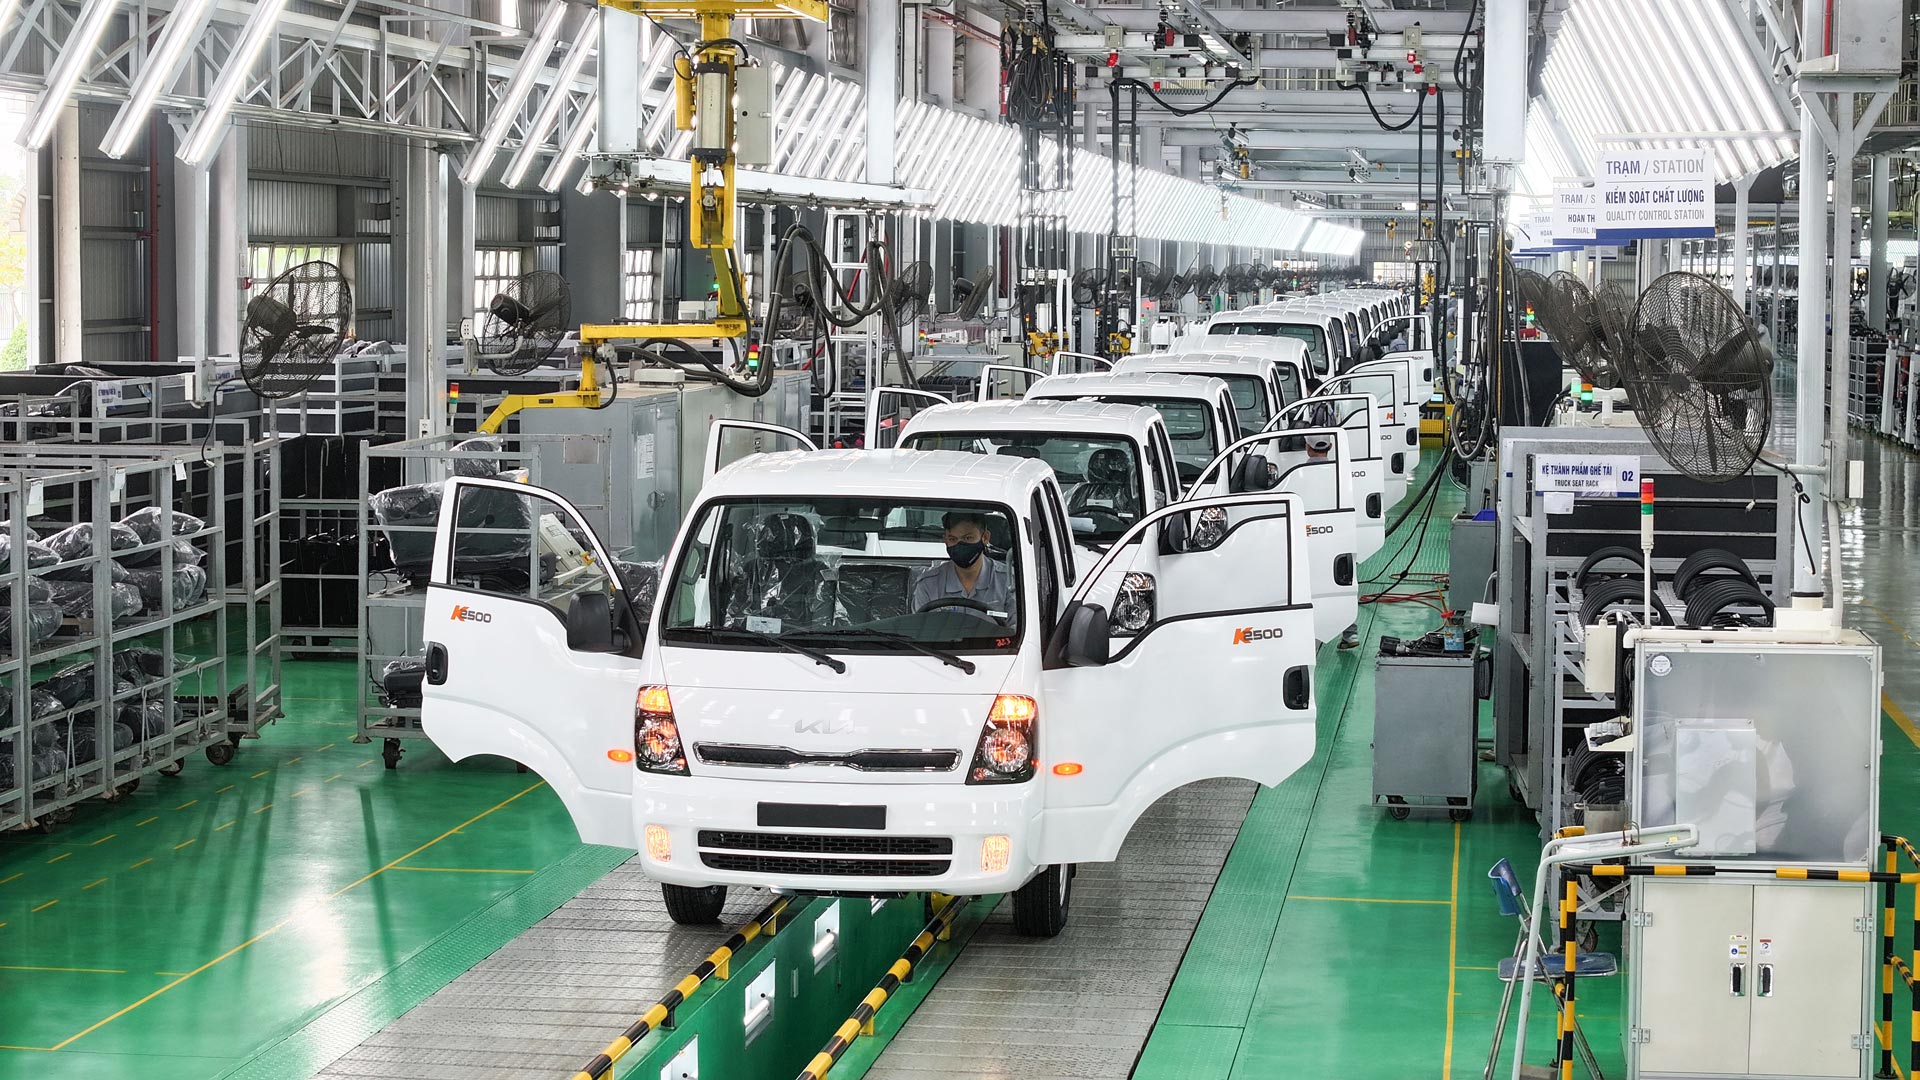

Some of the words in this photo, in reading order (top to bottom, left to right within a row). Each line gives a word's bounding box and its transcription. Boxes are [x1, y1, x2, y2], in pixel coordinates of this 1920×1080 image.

[1606, 160, 1640, 177] TRẠM
[1653, 159, 1704, 174] STATION
[1606, 186, 1626, 204] KIỂM
[1629, 188, 1650, 203] SOÁT
[1653, 186, 1675, 203] CHẤT
[1678, 188, 1704, 205] LƯỢNG
[1606, 210, 1636, 221] QUALITY
[1639, 210, 1672, 220] CONTROL
[1674, 209, 1704, 220] STATION
[1622, 471, 1634, 482] 02
[795, 720, 855, 734] KIA
